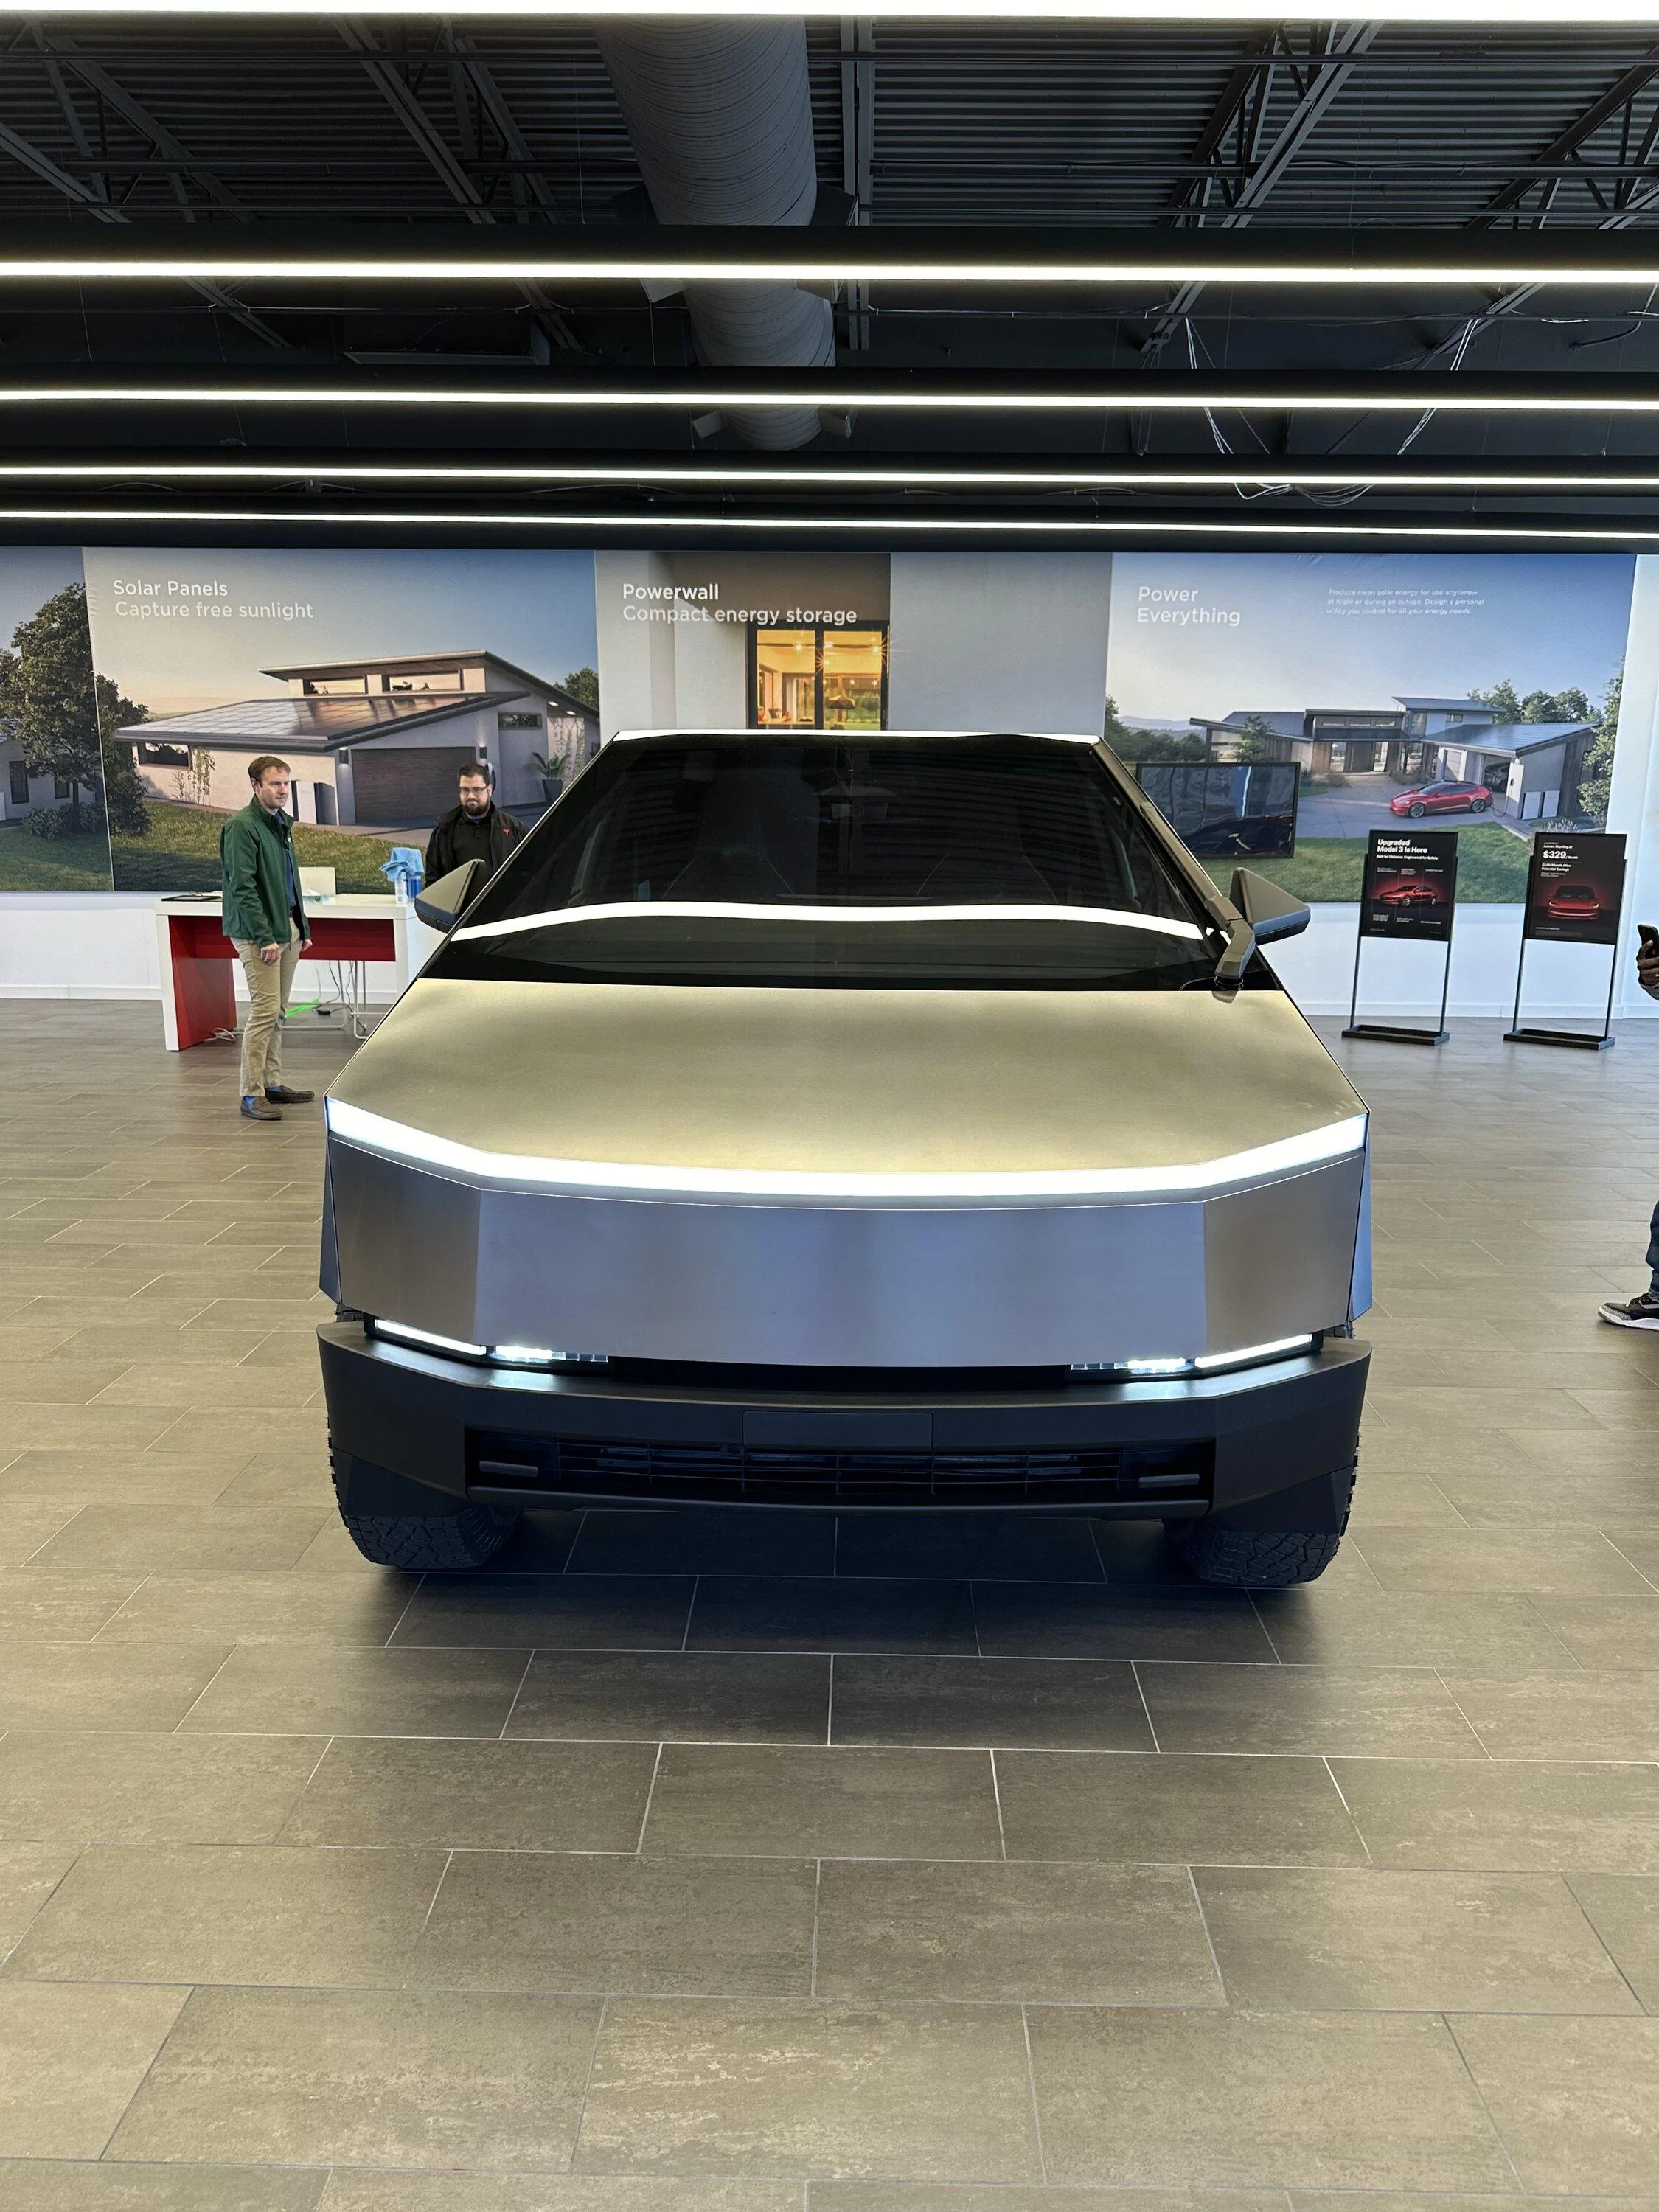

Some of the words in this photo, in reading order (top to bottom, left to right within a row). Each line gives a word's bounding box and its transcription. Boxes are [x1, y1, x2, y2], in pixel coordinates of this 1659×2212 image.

[113, 580, 161, 596] Solar
[167, 580, 229, 597] Panels
[622, 583, 719, 600] Powerwall
[1138, 586, 1199, 602] Power
[115, 601, 190, 619] Capture
[195, 602, 232, 618] free
[239, 602, 314, 621] sunlight
[622, 605, 709, 625] Compact
[714, 608, 780, 625] energy
[786, 607, 858, 625] storage
[1137, 608, 1240, 627] Everything
[1377, 839, 1411, 847] Upgraded
[1543, 850, 1566, 859] $329
